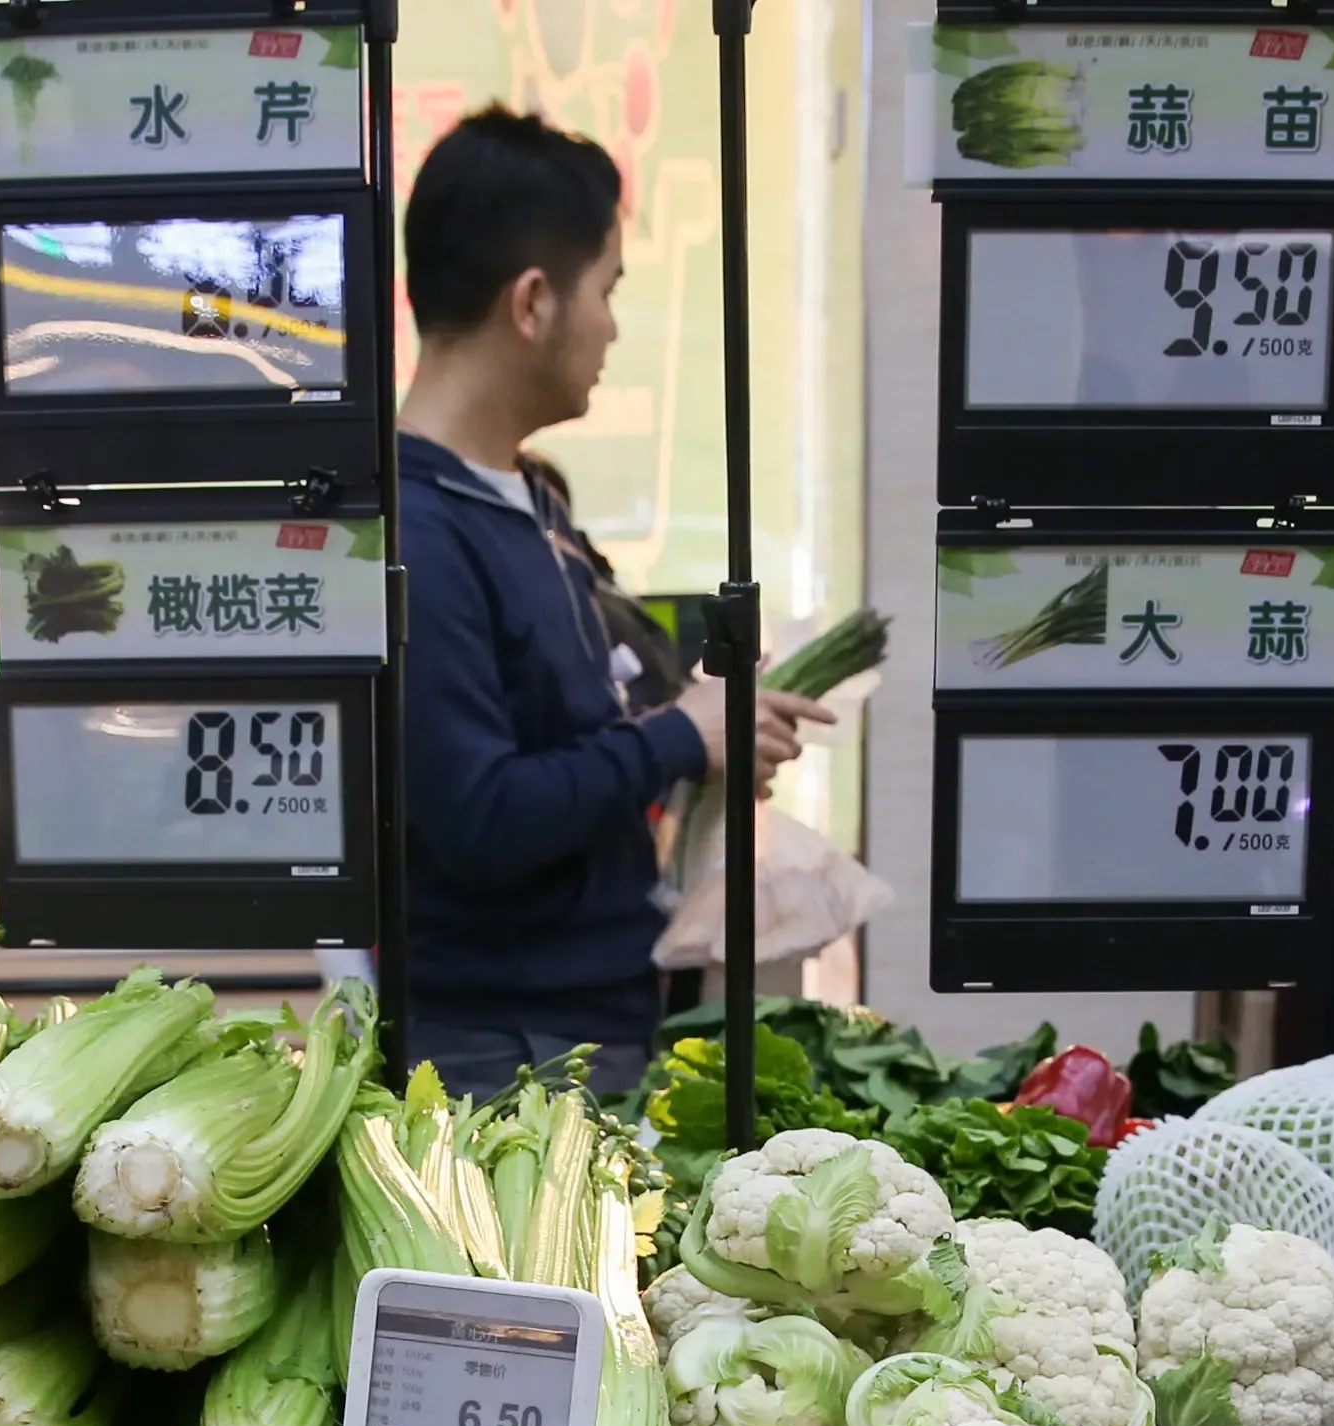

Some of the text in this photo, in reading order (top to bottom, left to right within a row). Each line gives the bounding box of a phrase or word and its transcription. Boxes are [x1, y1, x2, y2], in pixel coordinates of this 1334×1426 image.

[129, 81, 312, 146] 水芹
[1127, 84, 1323, 149] 蒜苗
[1163, 241, 1317, 357] 9.50
[147, 573, 322, 632] 橄榄菜
[1119, 600, 1308, 661] 大蒜
[184, 711, 325, 815] 8.50
[1157, 745, 1294, 851] 7.00
